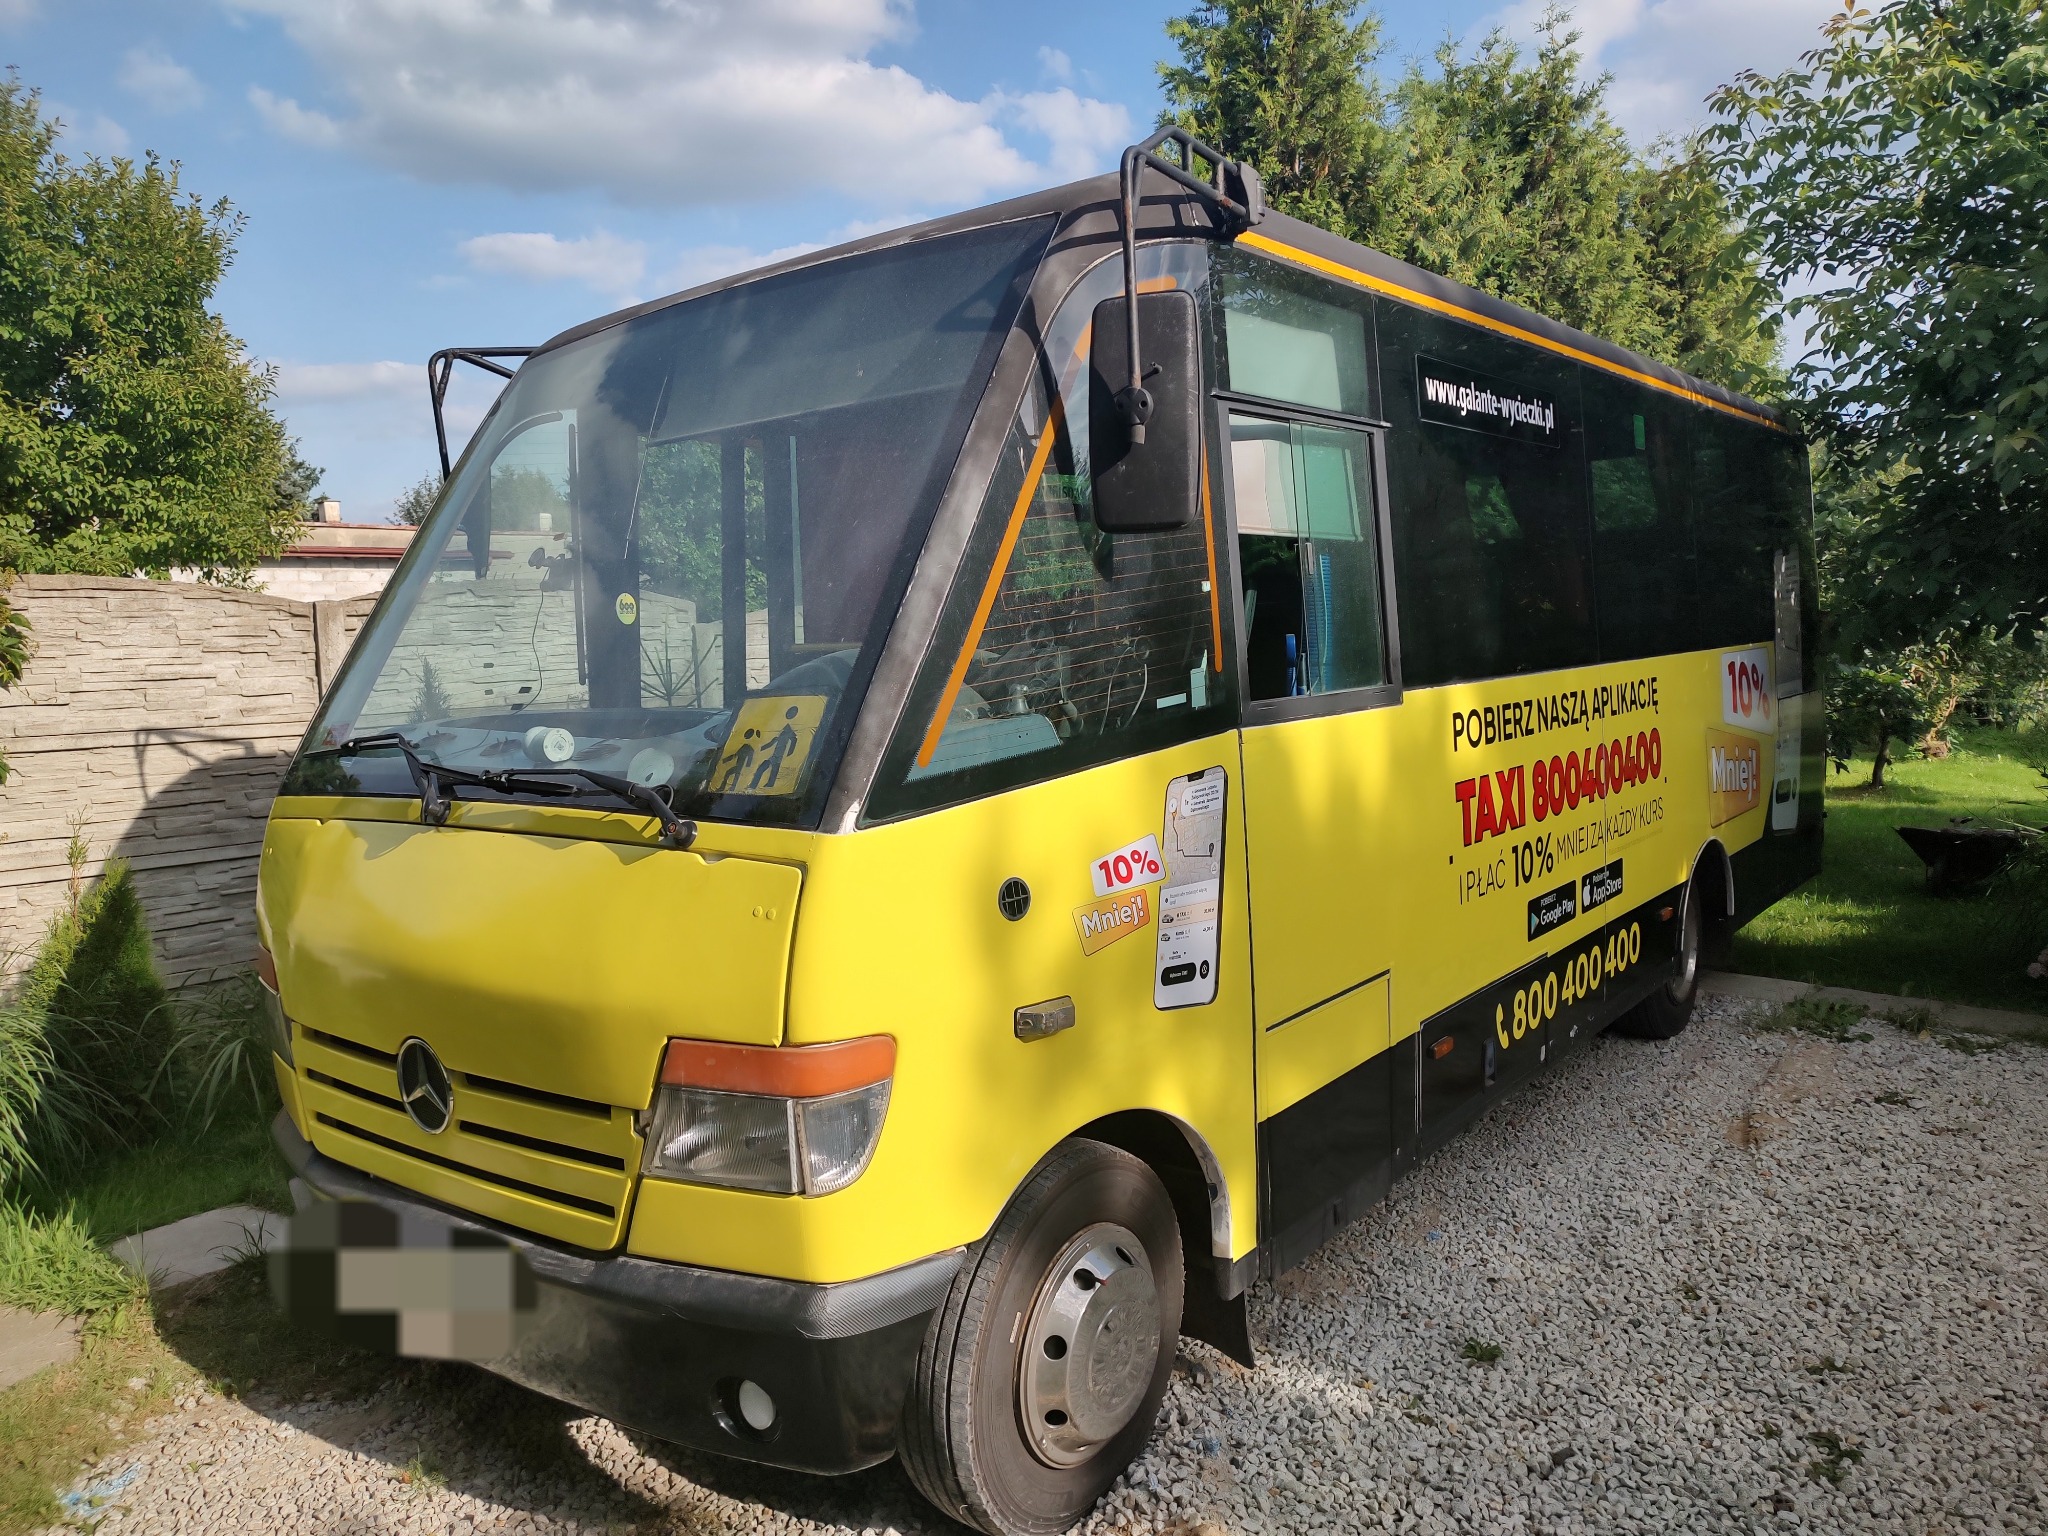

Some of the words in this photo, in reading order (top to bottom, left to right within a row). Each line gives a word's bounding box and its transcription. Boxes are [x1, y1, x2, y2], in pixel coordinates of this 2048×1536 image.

[1424, 376, 1555, 435] www.galante-wycieczki.pl
[1452, 699, 1535, 752] POBIERZ
[1536, 689, 1590, 732] NASZĄ
[1591, 676, 1659, 721] APLIKACJĘ
[1728, 660, 1771, 720] 10%
[1454, 764, 1527, 847] TAXI
[1532, 727, 1662, 823] 800400400
[1711, 744, 1758, 804] Mniej!
[1098, 849, 1160, 888] 10%
[1459, 874, 1463, 905] I
[1466, 849, 1507, 902] PŁAĆ
[1511, 832, 1554, 888] 10%
[1556, 826, 1589, 864] MNIEJ
[1590, 819, 1605, 850] ZA
[1606, 806, 1639, 843] KAŻDY
[1639, 796, 1664, 828] KURS
[1081, 895, 1144, 939] Mniej!
[1540, 903, 1562, 926] Google
[1562, 898, 1575, 915] Play
[1592, 885, 1606, 904] App
[1606, 877, 1622, 895] Store
[1512, 971, 1558, 1040] 800
[1561, 945, 1602, 1006] 400
[1604, 922, 1641, 978] 400
